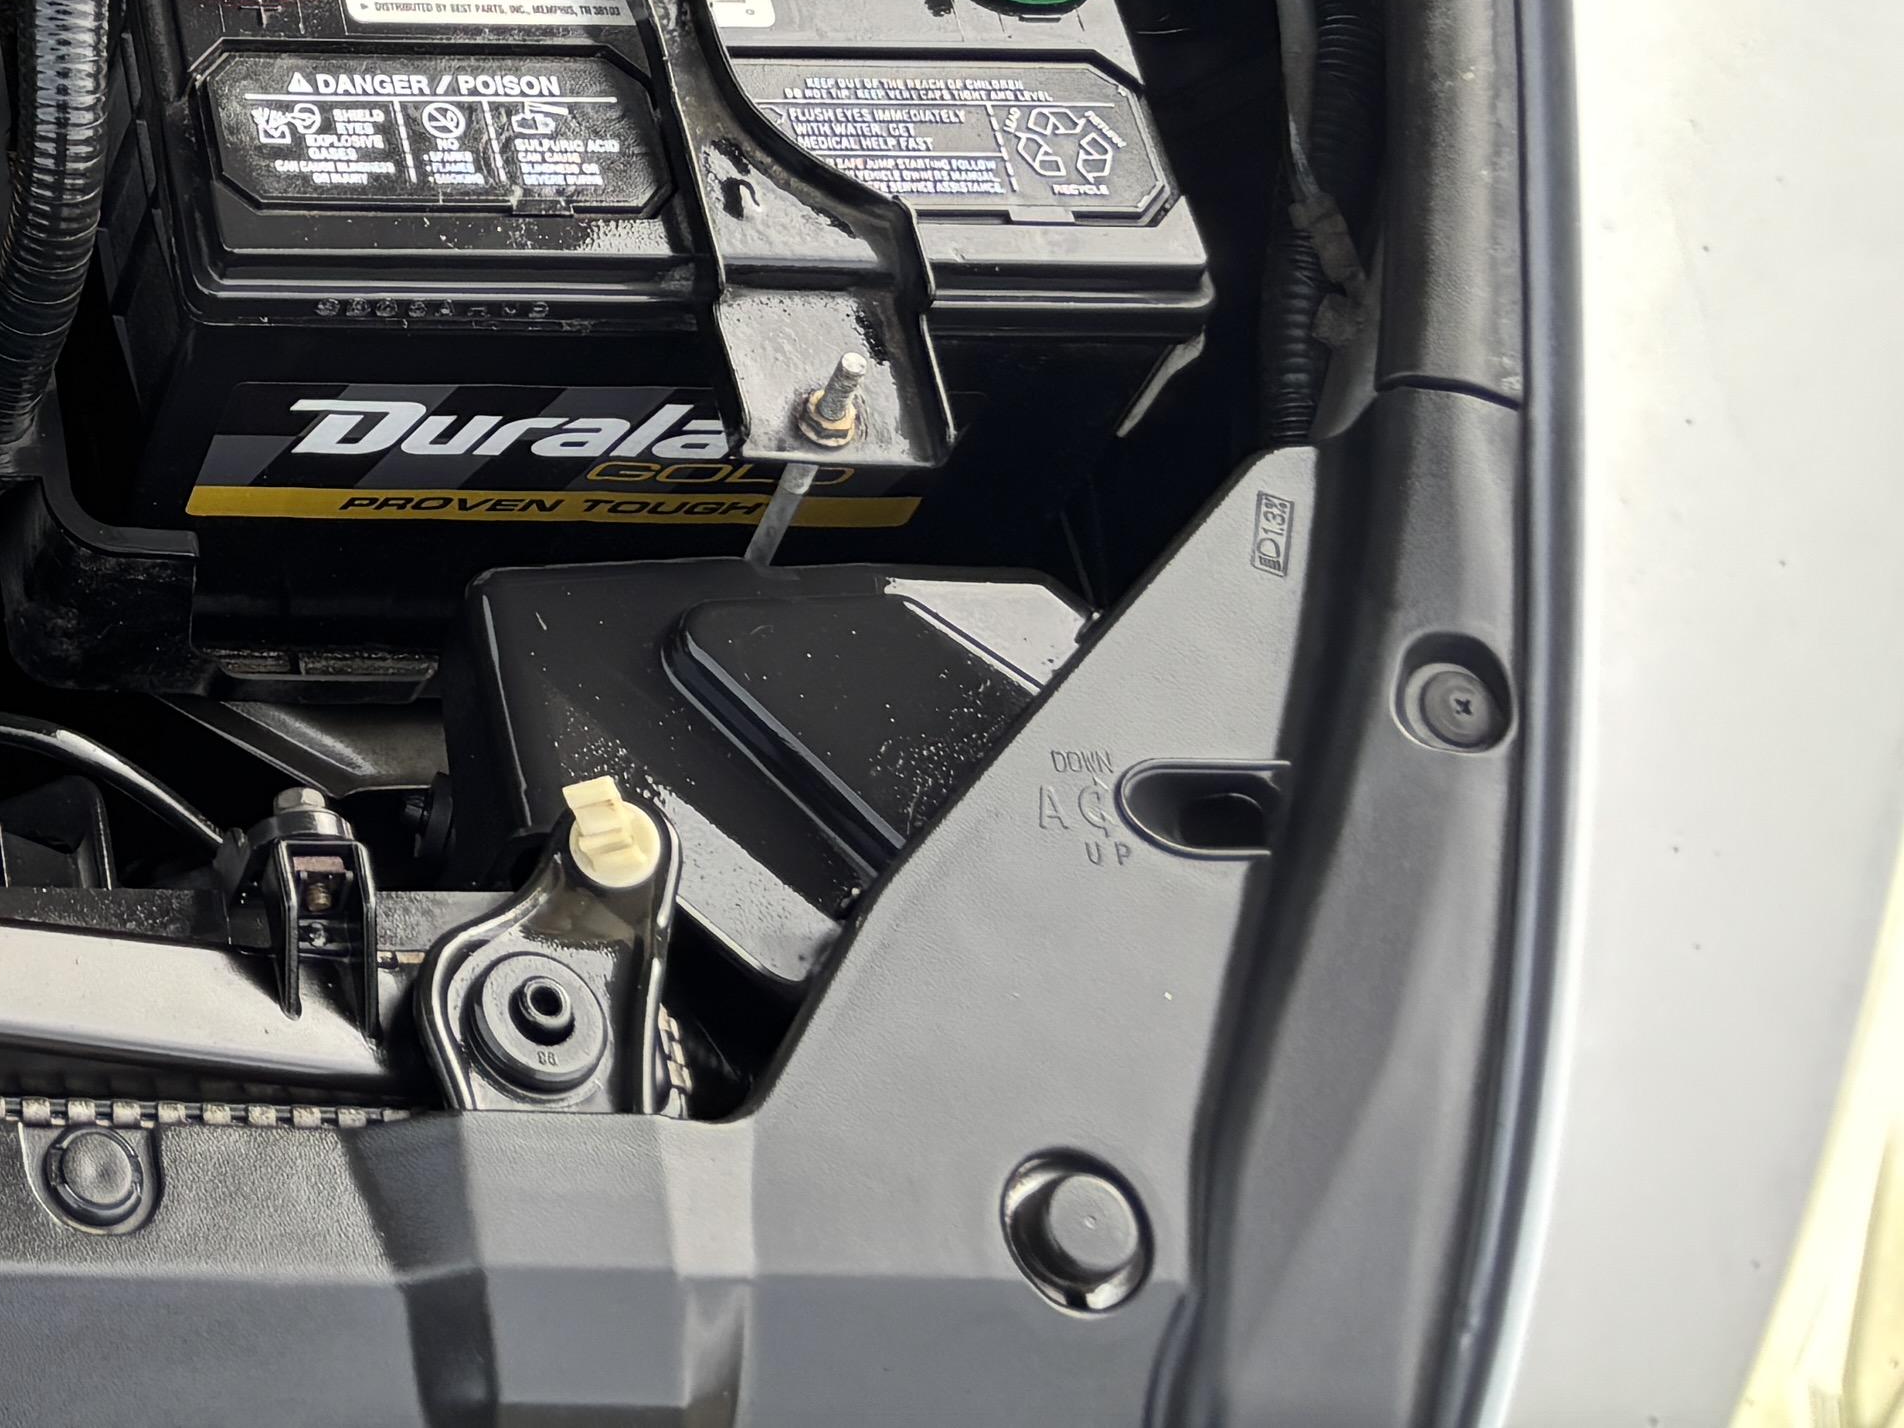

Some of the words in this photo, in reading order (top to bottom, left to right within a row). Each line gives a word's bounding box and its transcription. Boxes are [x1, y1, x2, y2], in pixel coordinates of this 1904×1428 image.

[316, 75, 430, 95] DANGER
[458, 75, 561, 96] POISON
[333, 109, 385, 122] SHIELD
[788, 107, 835, 123] FLUSH
[838, 108, 872, 123] EYES
[874, 108, 966, 124] IMMEDIATELY
[336, 122, 374, 134] EYES
[793, 123, 830, 137] WITH
[889, 124, 915, 137] GET
[306, 134, 384, 148] EXPLOSIVE
[437, 138, 460, 150] NO
[587, 140, 620, 153] ACID
[797, 136, 860, 151] MEDICAL
[862, 137, 897, 151] HELP
[900, 138, 934, 151] FAST
[308, 147, 358, 160] GASES
[518, 152, 541, 163] CAN
[544, 153, 582, 163] CAUSE
[952, 159, 996, 171] FOLLOW
[1052, 184, 1110, 197] RECYCLE
[289, 398, 731, 459] Durala
[583, 461, 856, 486] GOLD
[339, 495, 563, 515] PROVEN
[582, 498, 769, 518] TOUGH
[1051, 750, 1115, 775] DOWN
